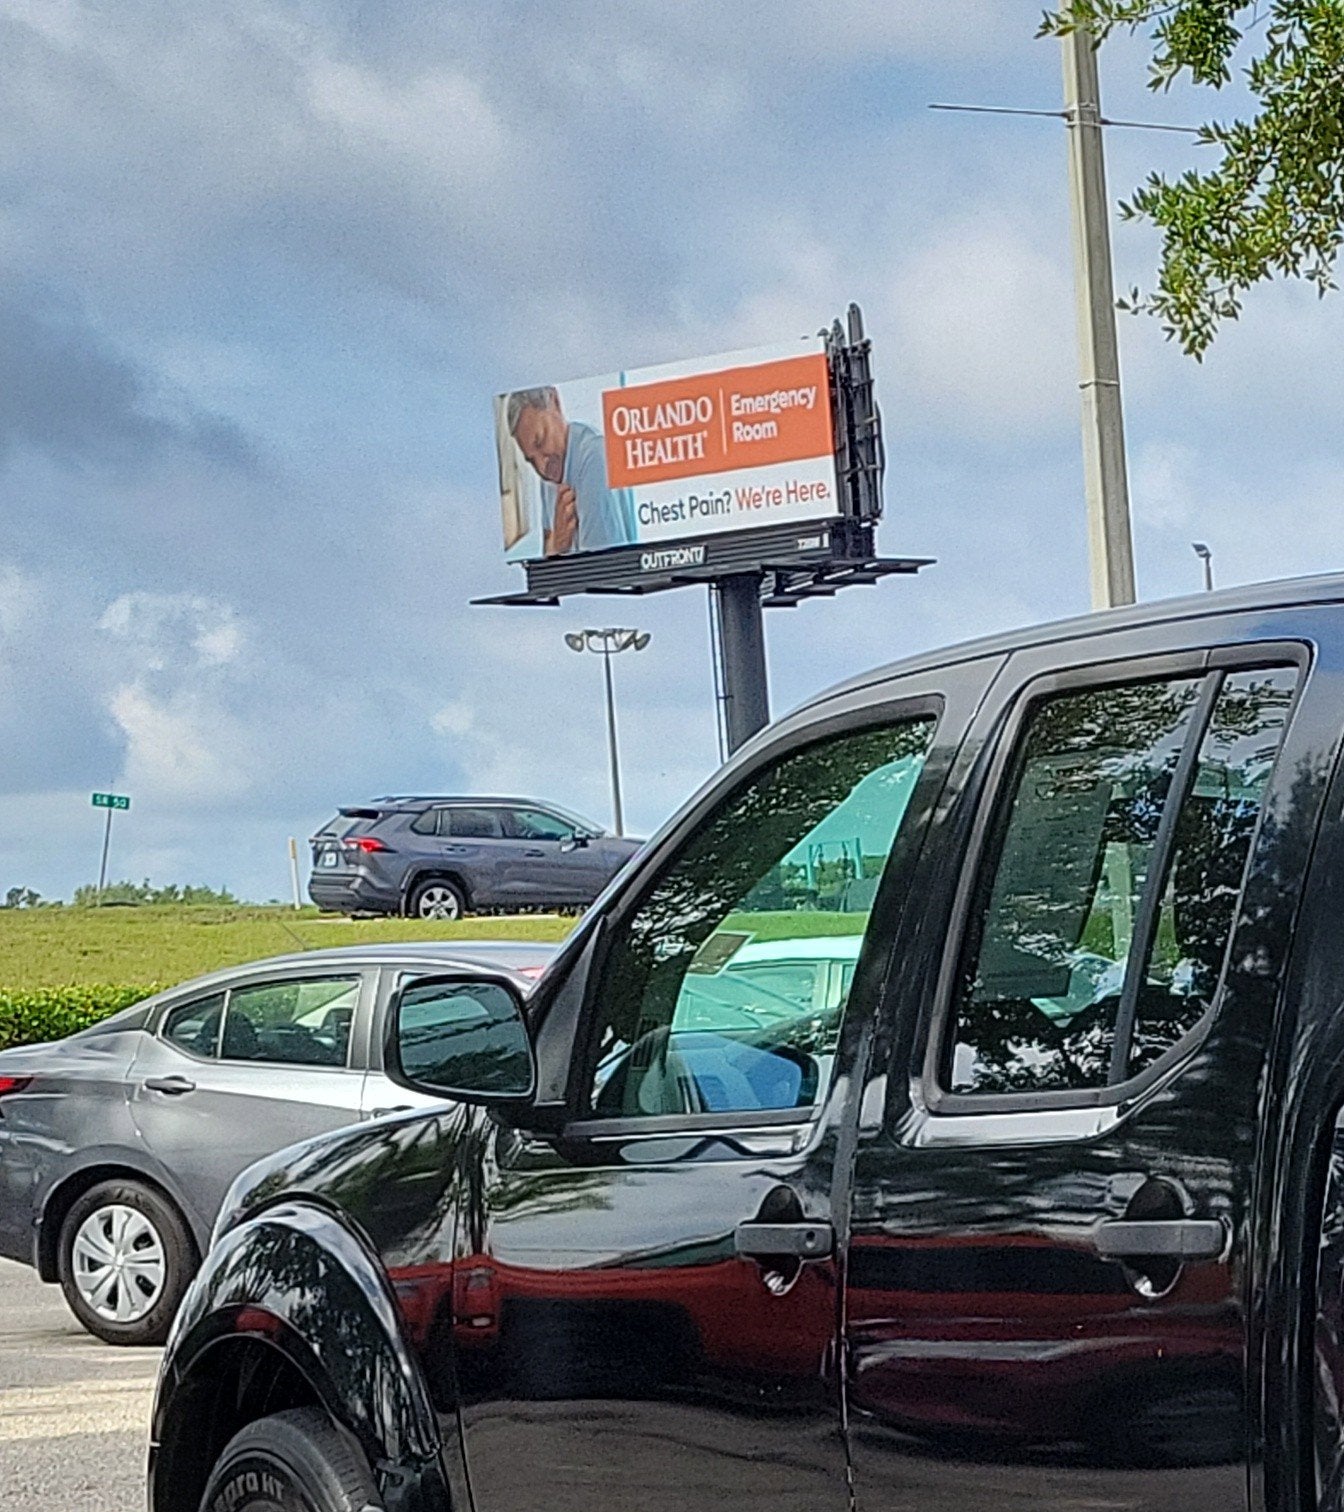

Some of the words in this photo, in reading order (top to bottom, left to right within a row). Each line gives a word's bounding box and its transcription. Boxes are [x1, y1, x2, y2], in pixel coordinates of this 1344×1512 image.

[612, 396, 713, 436] ORLANDO
[731, 386, 817, 416] Emergency
[732, 420, 778, 443] Room
[625, 432, 705, 469] HEALTH
[638, 498, 686, 525] Chest
[689, 491, 732, 518] Pain?
[735, 485, 782, 511] We're
[785, 479, 831, 505] Here.
